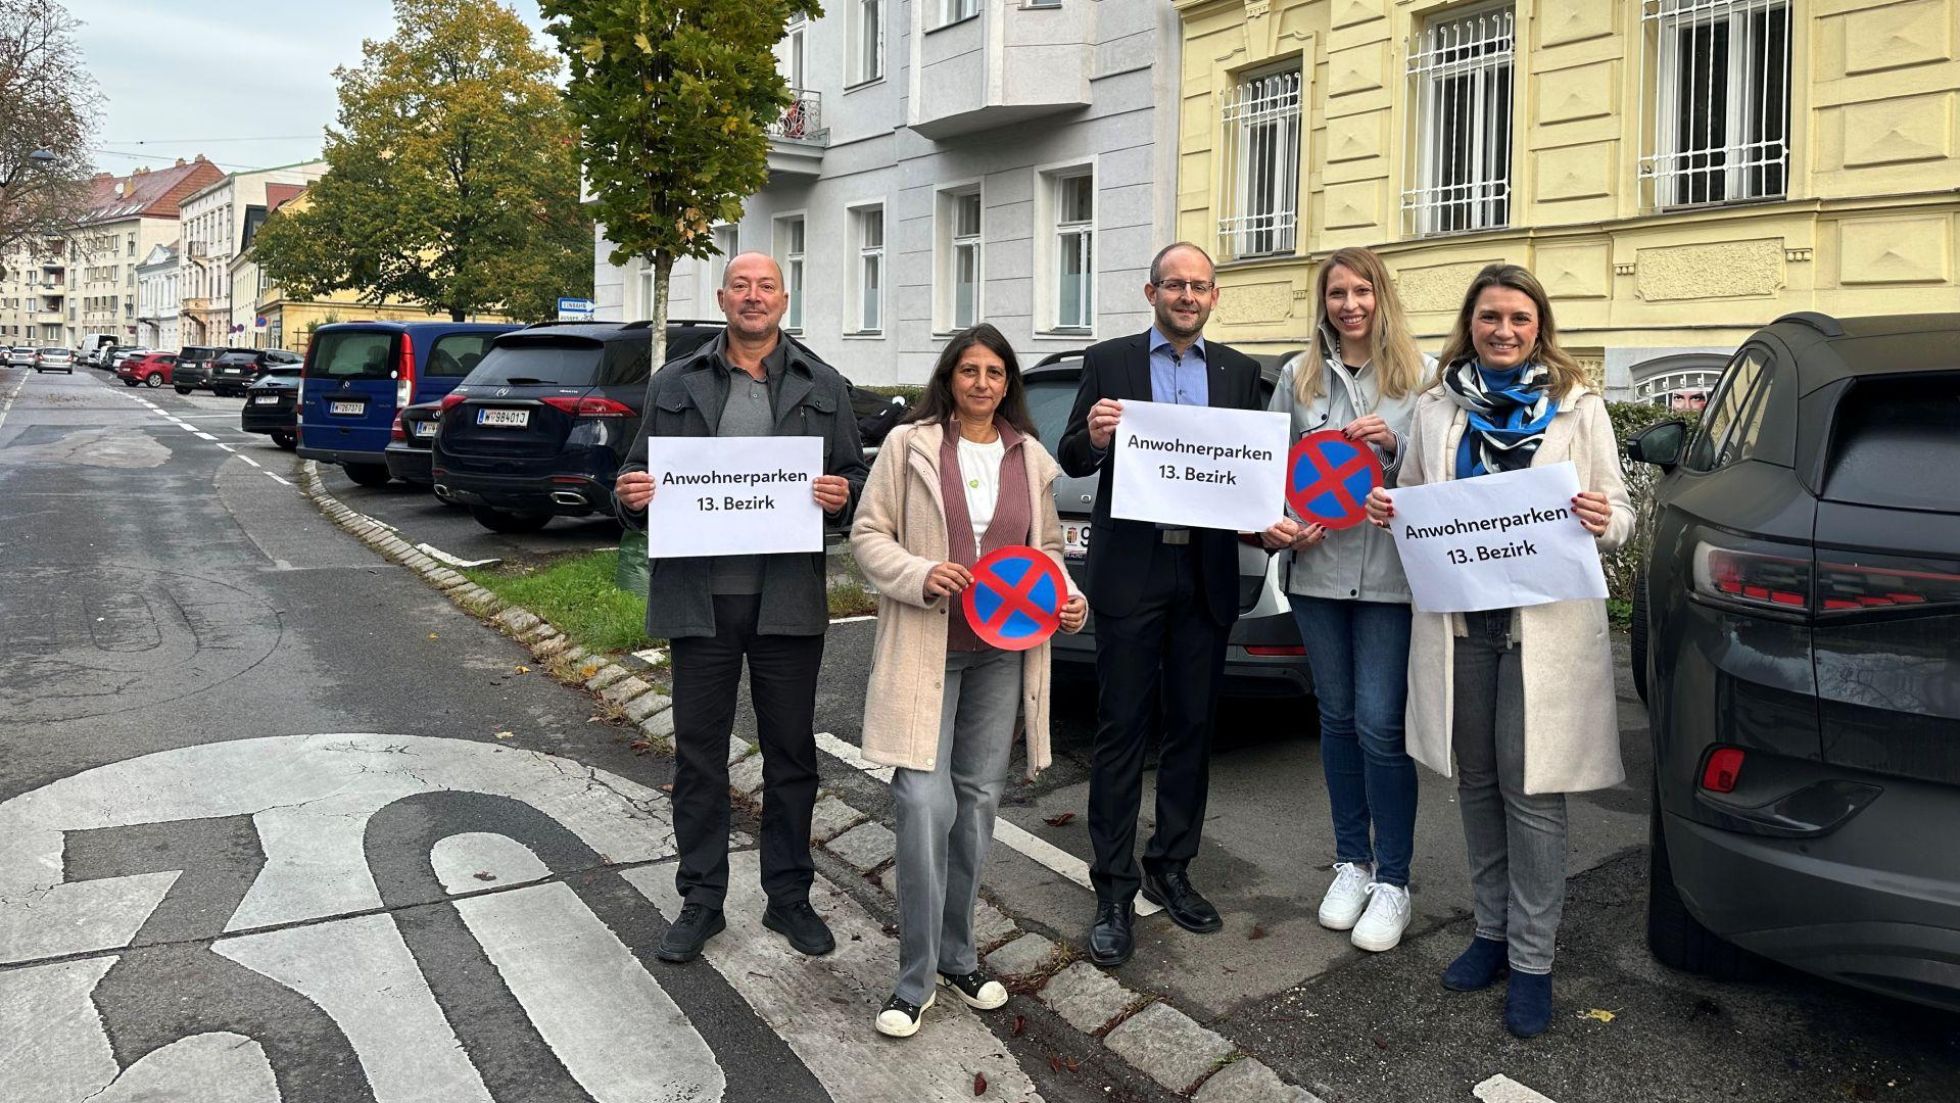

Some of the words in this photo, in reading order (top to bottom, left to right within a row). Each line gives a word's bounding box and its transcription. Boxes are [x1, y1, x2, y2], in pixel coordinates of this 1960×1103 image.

[1127, 434, 1273, 461] Anwohnerparken
[662, 468, 808, 487] Anwohnerparken
[1158, 464, 1181, 480] 13.
[1185, 466, 1237, 486] Bezirk
[696, 497, 719, 511] 13.
[724, 495, 775, 511] Bezirk
[1404, 507, 1569, 540] Anwohnerparken
[1446, 548, 1474, 566] 13.
[1477, 540, 1538, 562] Bezirk
